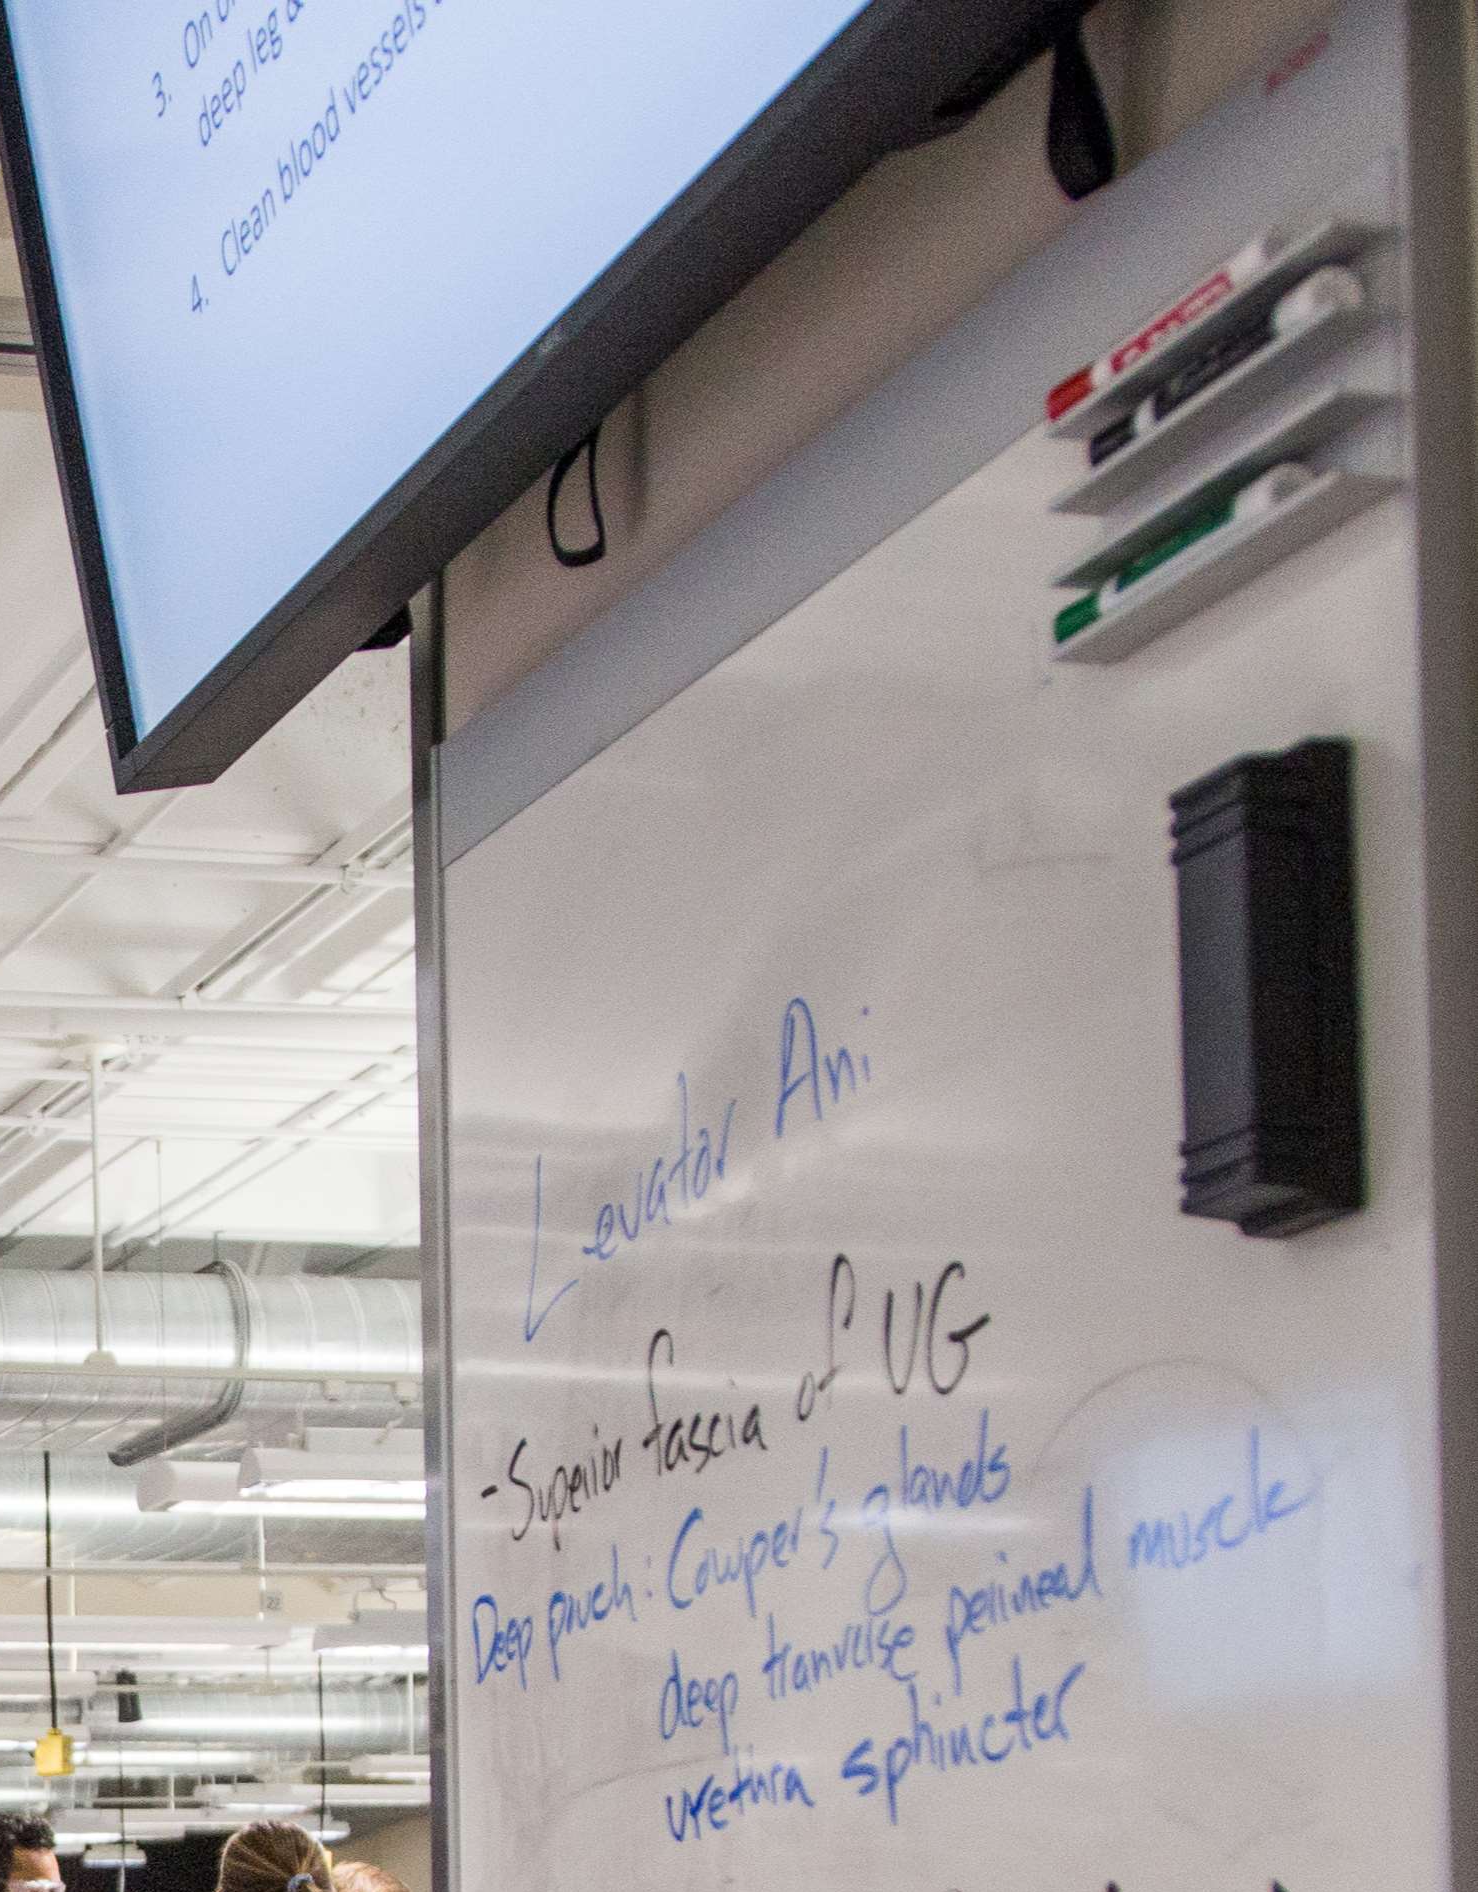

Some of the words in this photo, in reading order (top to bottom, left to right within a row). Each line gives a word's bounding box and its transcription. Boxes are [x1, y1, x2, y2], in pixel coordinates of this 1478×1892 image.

[151, 72, 172, 118] 3.
[183, 10, 213, 69] On
[191, 274, 210, 314] 4.
[221, 187, 278, 276] Clean
[277, 86, 341, 202] blood
[343, 0, 427, 114] vessels
[198, 60, 247, 147] deep
[248, 7, 283, 73] leg
[524, 1071, 737, 1342] Levator
[775, 996, 871, 1138] Ani
[643, 1328, 768, 1477] fascia
[796, 1253, 856, 1422] of
[884, 1260, 991, 1395] UG
[472, 1593, 533, 1691] Deep
[863, 1407, 1010, 1617] glands
[659, 1648, 739, 1756] deep
[665, 1748, 816, 1844] urethra
[842, 1653, 1086, 1826] sphincter
